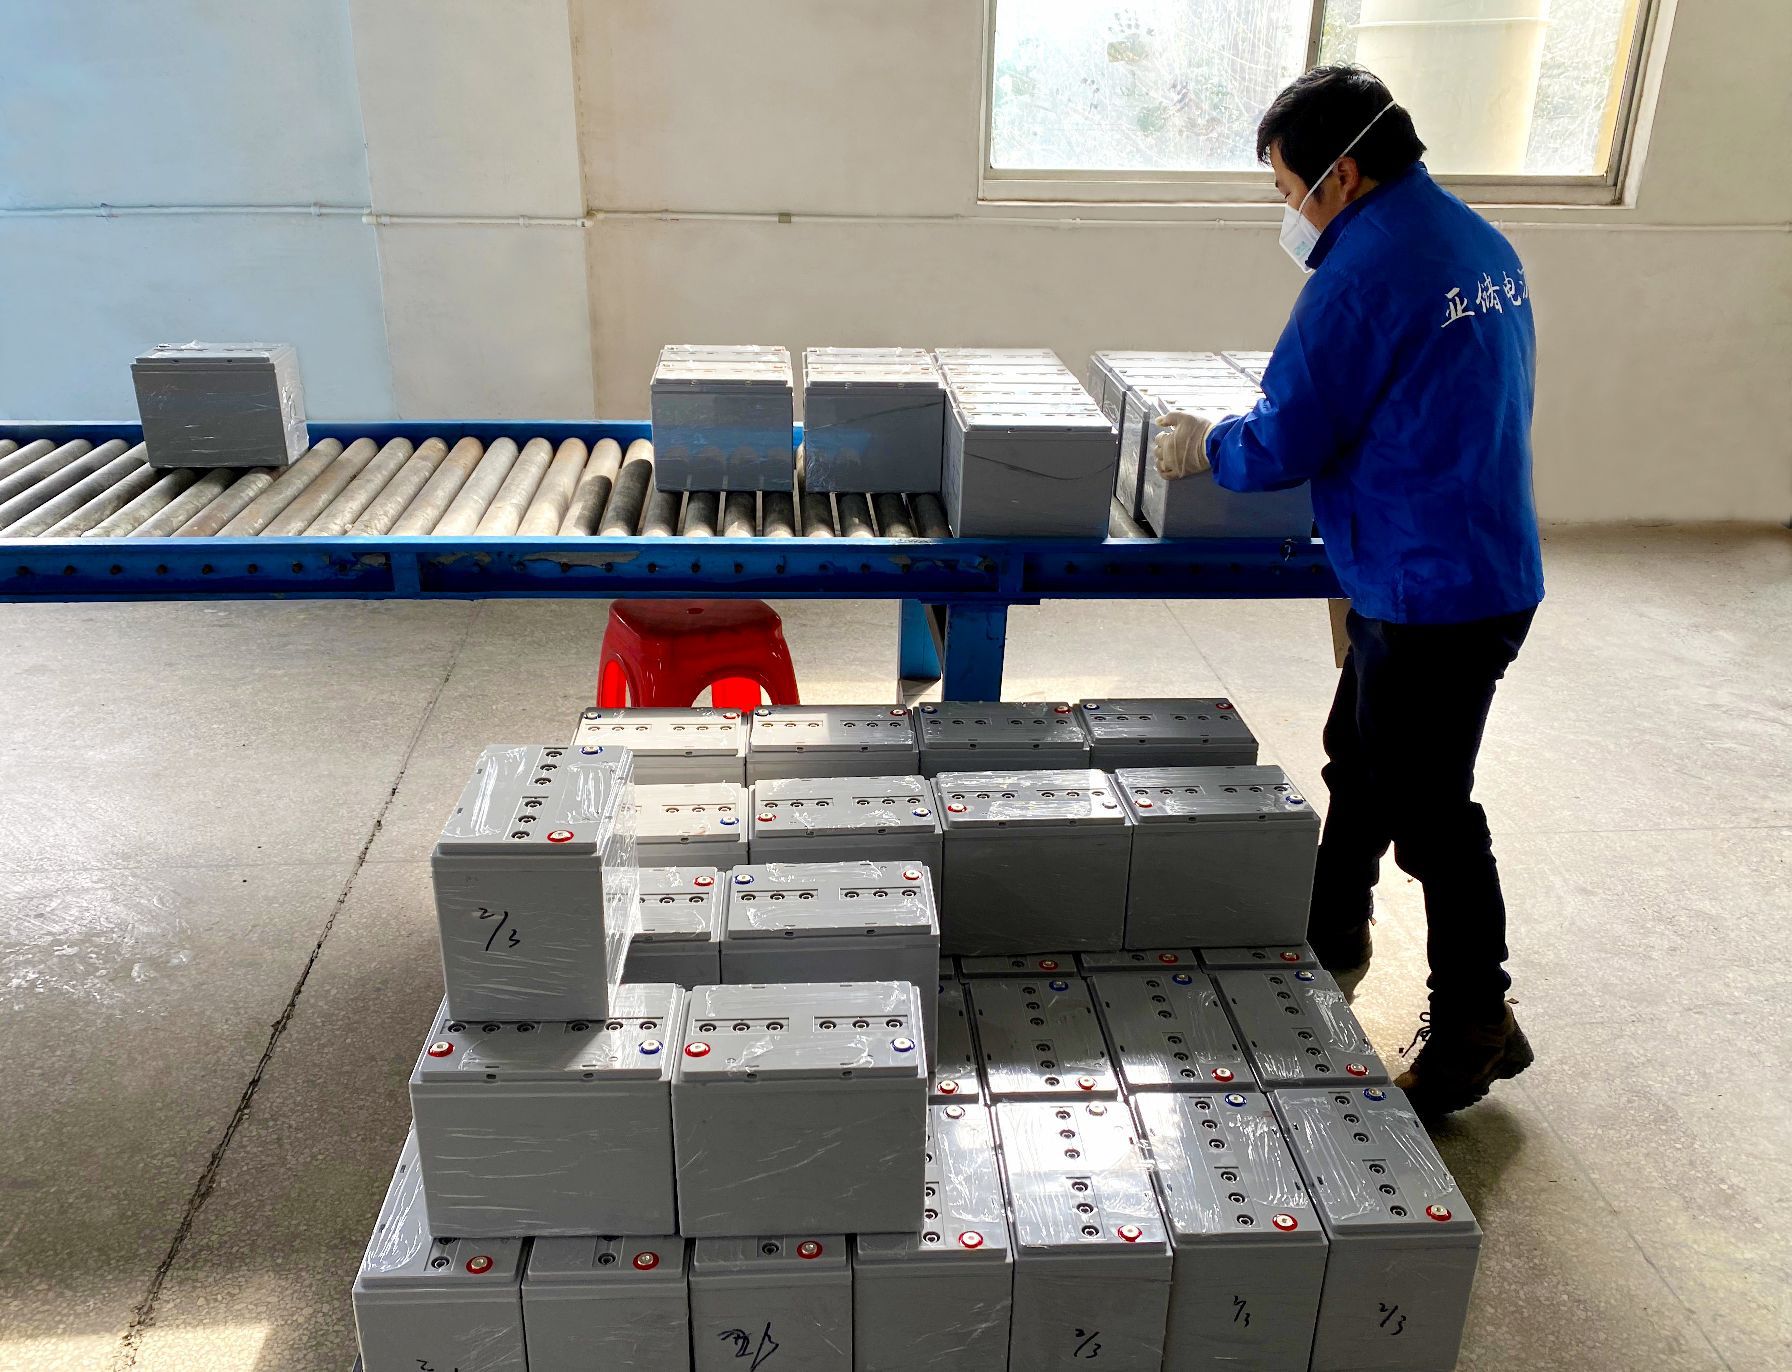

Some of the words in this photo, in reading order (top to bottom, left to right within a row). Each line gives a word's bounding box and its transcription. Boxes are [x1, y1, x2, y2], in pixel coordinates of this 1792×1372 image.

[479, 907, 521, 952] 2/3
[1379, 1302, 1406, 1335] 2/3
[1074, 1328, 1102, 1359] 2/3
